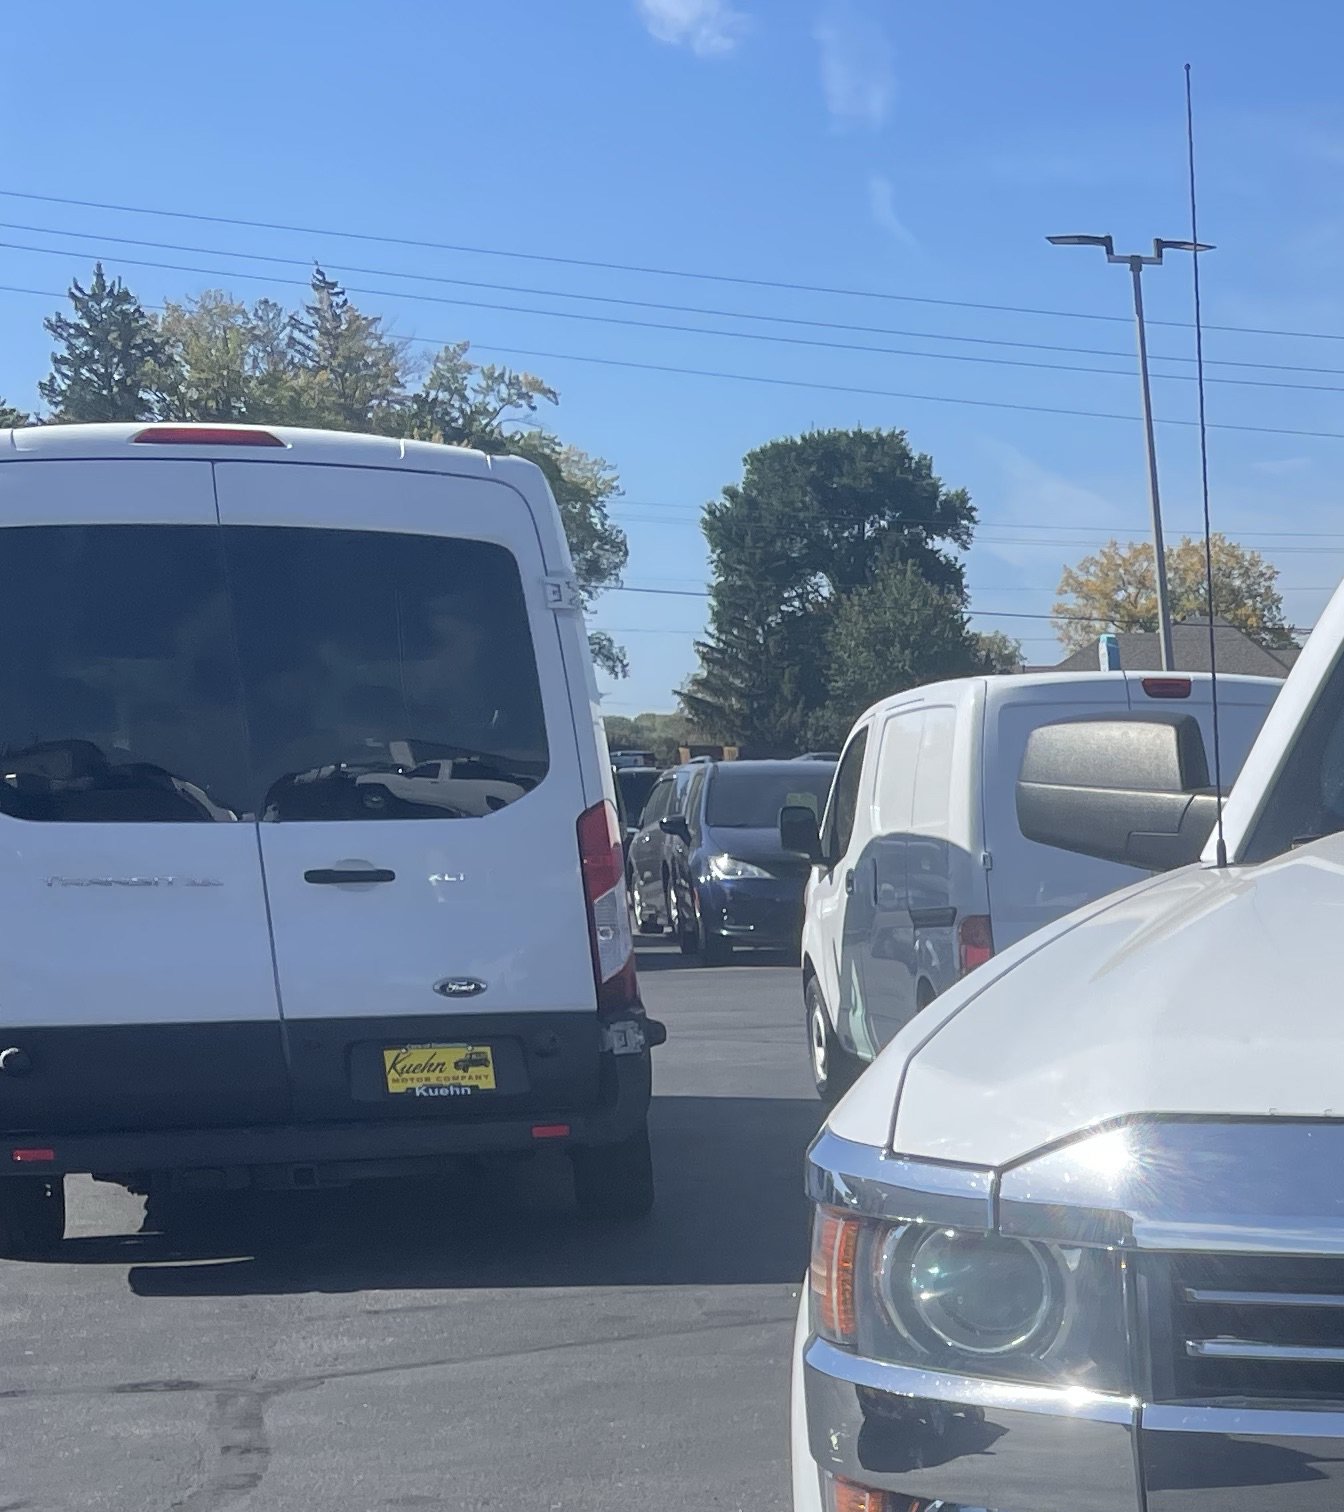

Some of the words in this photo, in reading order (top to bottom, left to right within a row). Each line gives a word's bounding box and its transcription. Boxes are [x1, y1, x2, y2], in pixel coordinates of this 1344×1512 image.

[387, 1052, 448, 1077] Kuehn
[391, 1076, 432, 1085] MOTOR
[435, 1074, 490, 1083] COMPANY
[415, 1085, 472, 1098] Kuehn
